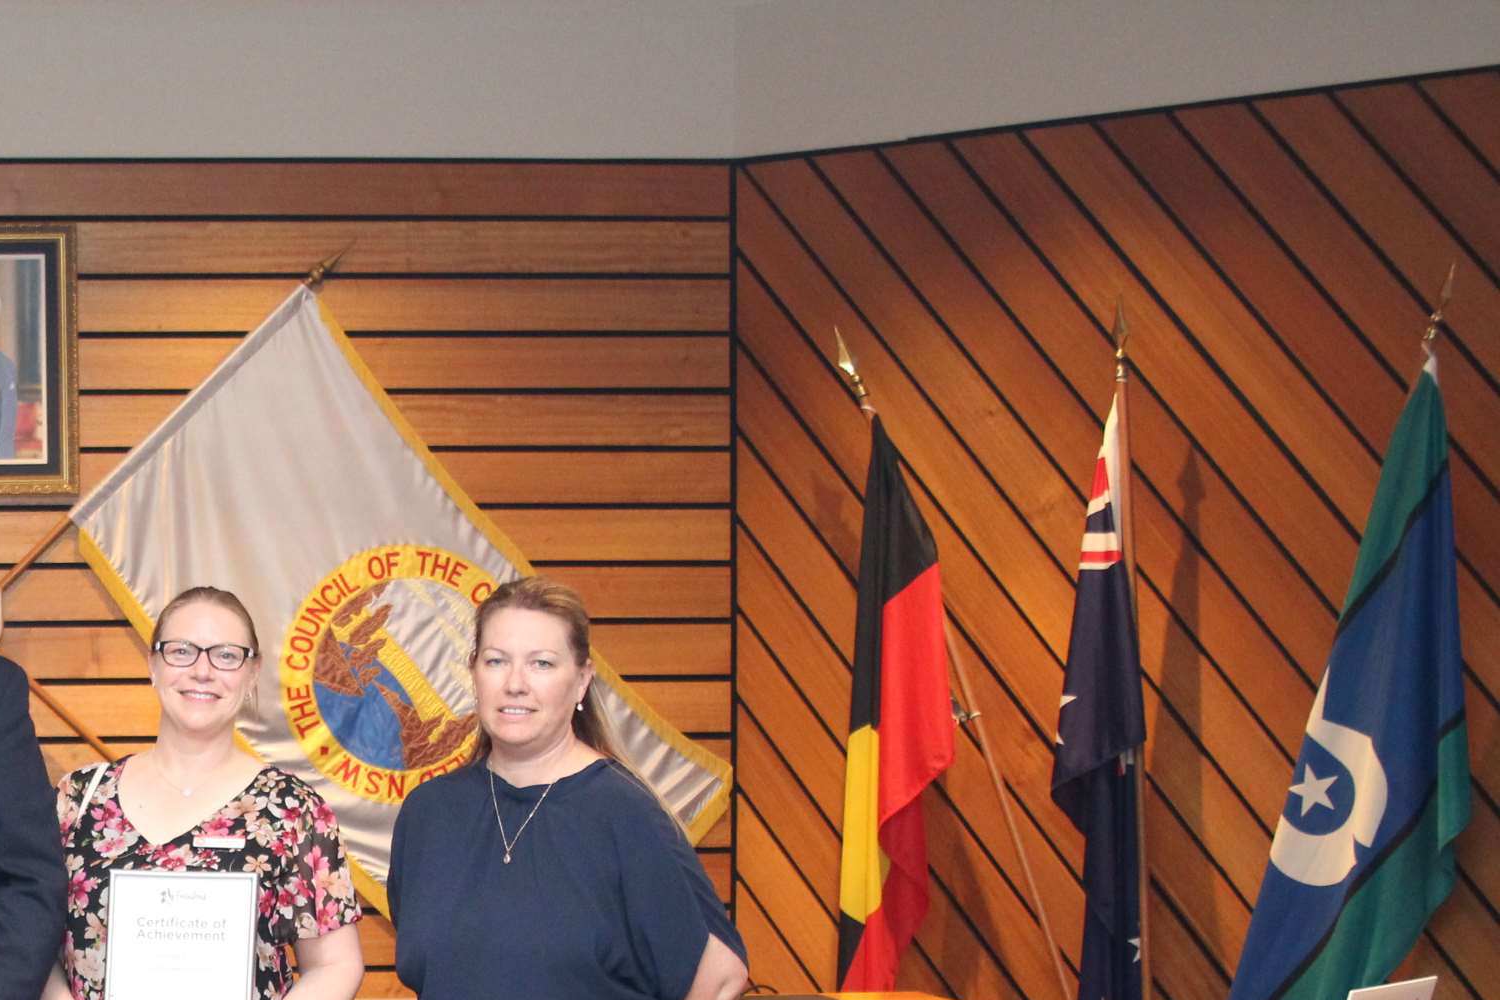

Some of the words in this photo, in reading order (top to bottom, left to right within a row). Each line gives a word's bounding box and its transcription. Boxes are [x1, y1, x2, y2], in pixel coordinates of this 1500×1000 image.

[367, 552, 401, 580] OF
[416, 551, 469, 587] THE
[286, 573, 361, 671] COUNCIL
[287, 684, 320, 740] THE
[136, 916, 208, 929] Certificate
[213, 917, 227, 929] of
[136, 929, 226, 942] Achievement
